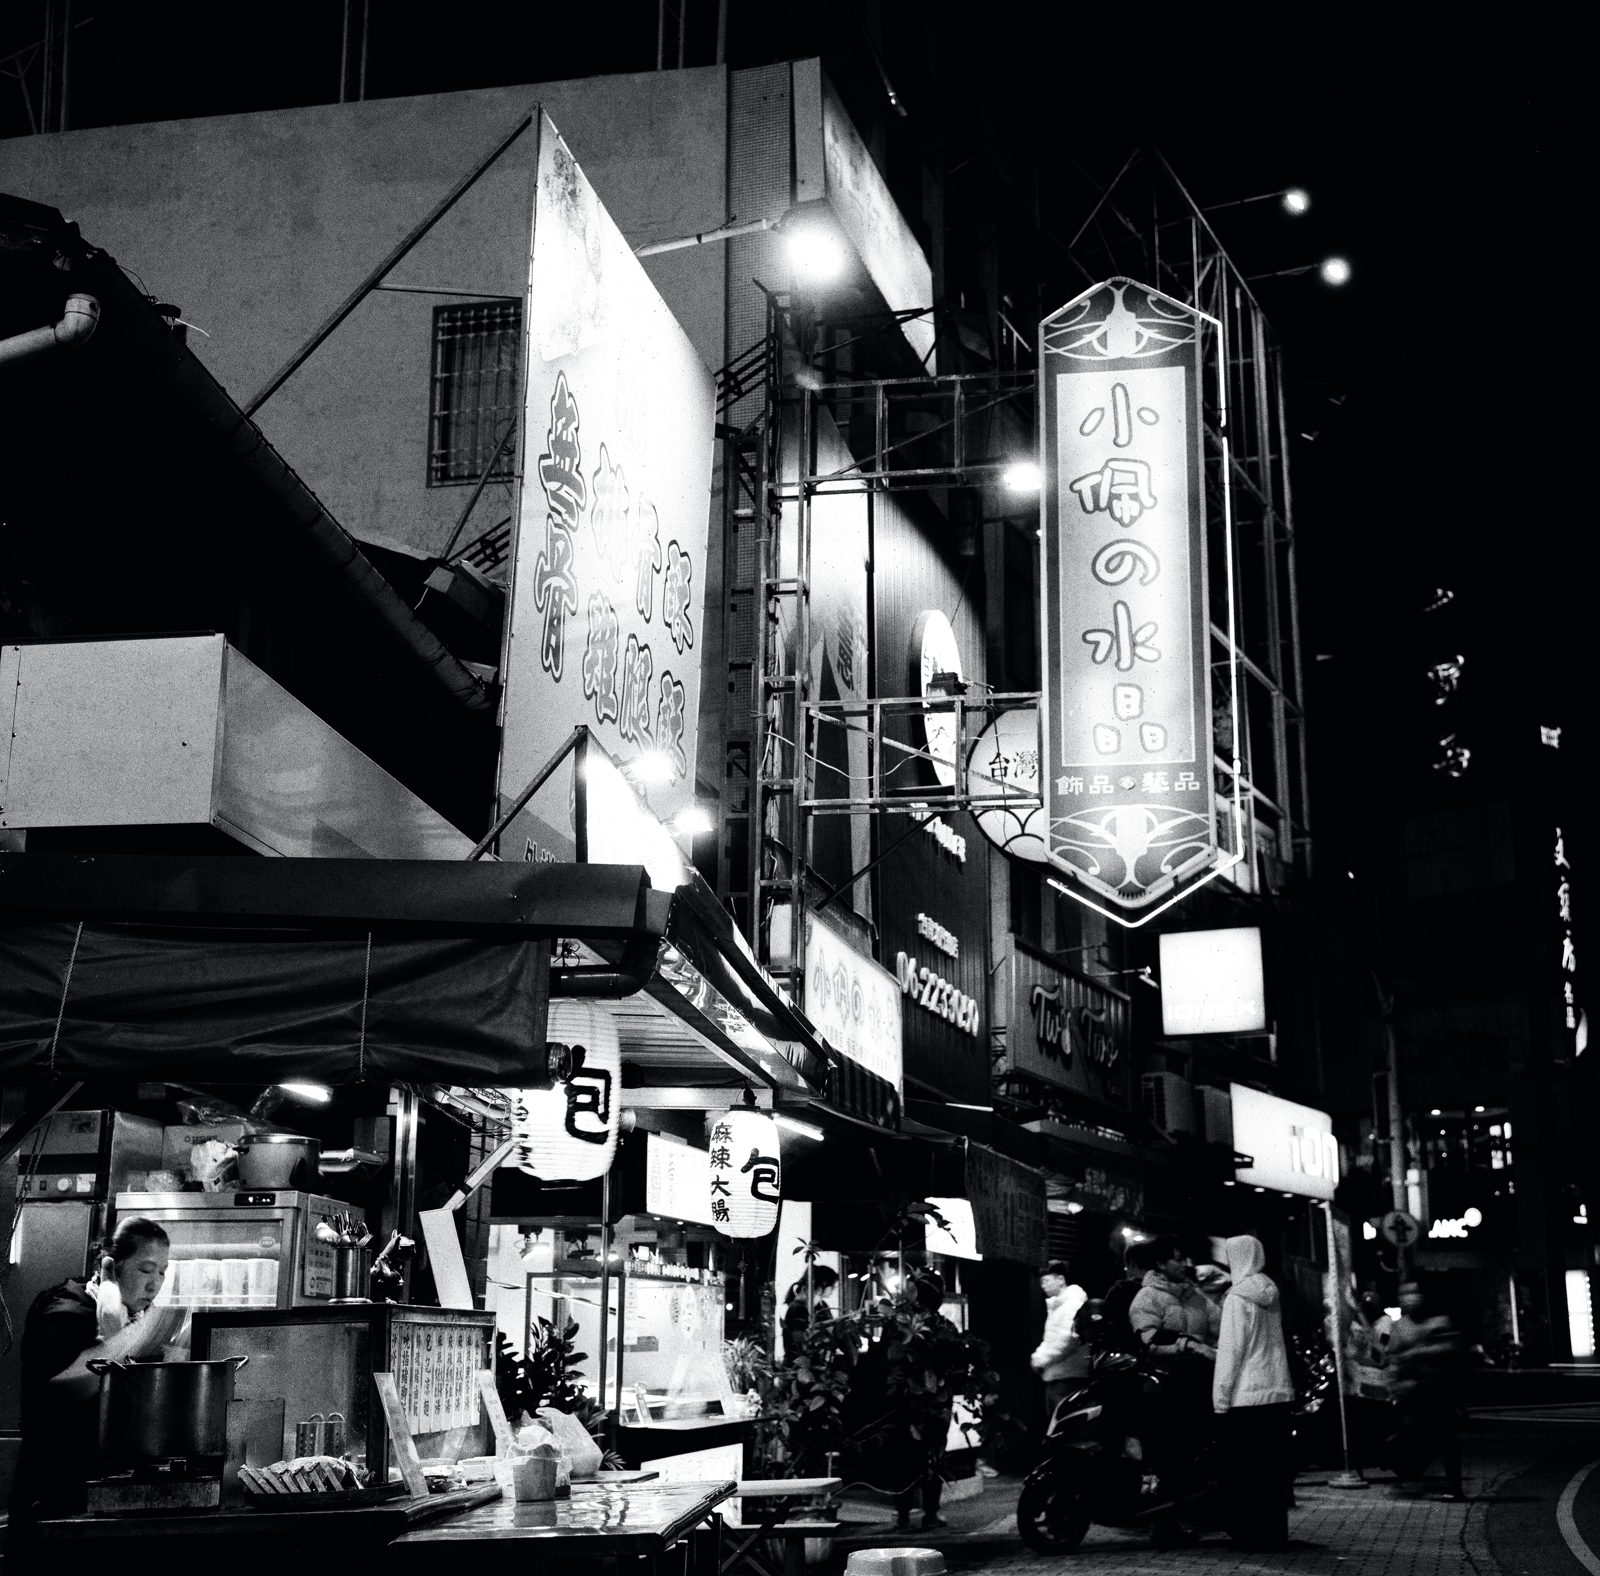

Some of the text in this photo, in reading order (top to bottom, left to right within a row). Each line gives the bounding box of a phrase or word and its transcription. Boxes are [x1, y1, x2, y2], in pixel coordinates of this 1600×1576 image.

[533, 369, 587, 683] 無骨
[988, 750, 1038, 780] 台灣
[1055, 771, 1200, 796] 飾品 藝品
[709, 1121, 733, 1223] 麻辣大腸
[740, 1147, 781, 1205] 包
